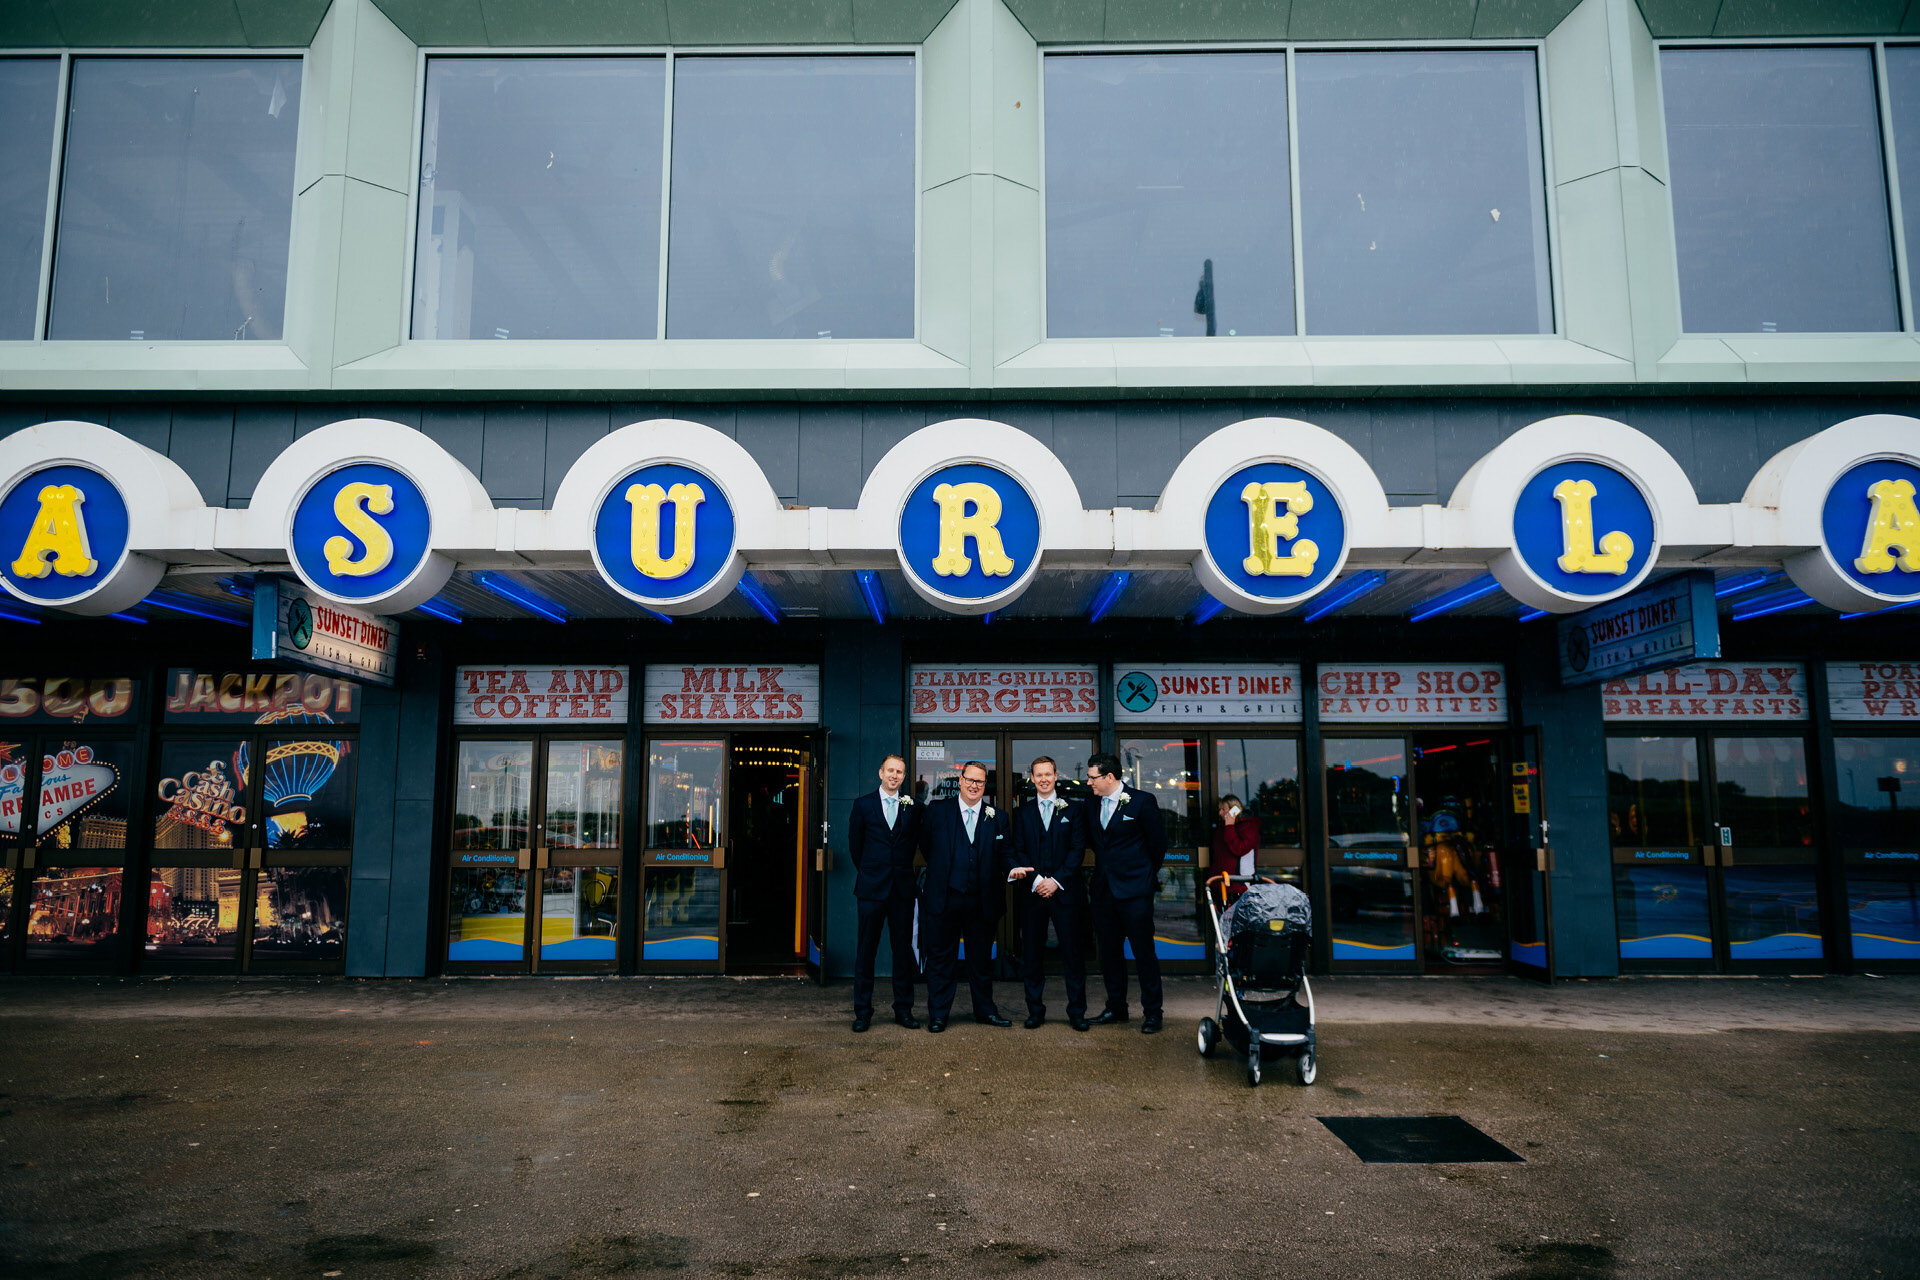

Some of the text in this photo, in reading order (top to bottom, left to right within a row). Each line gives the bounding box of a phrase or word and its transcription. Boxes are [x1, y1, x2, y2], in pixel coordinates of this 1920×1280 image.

[316, 605, 390, 650] SUNSET DINER
[1591, 596, 1680, 645] SUNSET DINER
[315, 643, 340, 660] FISH
[361, 657, 389, 674] GRILL
[1593, 650, 1619, 667] FISH
[1643, 633, 1684, 654] GRILL
[463, 669, 624, 694] TEA AND
[681, 667, 784, 693] MILK
[914, 672, 1094, 686] FLAME-GRILLED
[1319, 671, 1502, 695] CHIP SHOP
[1602, 668, 1798, 695] ALL-DAY
[1859, 664, 1920, 679] TOA
[166, 672, 358, 713] JACKPOT
[1160, 675, 1295, 695] SUNSET DINER
[473, 694, 612, 718] COFFEE
[660, 693, 803, 719] SHAKES
[912, 688, 1097, 713] BURGERS
[1161, 704, 1299, 713] FISH & GRILL
[1320, 697, 1498, 713] FAVOURITES
[1604, 698, 1802, 715] BREAKFASTS
[182, 771, 235, 804] Cash
[157, 777, 247, 825] Casino
[473, 854, 515, 863] Conditioning
[666, 853, 709, 861] Conditioning
[1354, 851, 1398, 861] Conditioning
[1646, 851, 1689, 860] Conditioning
